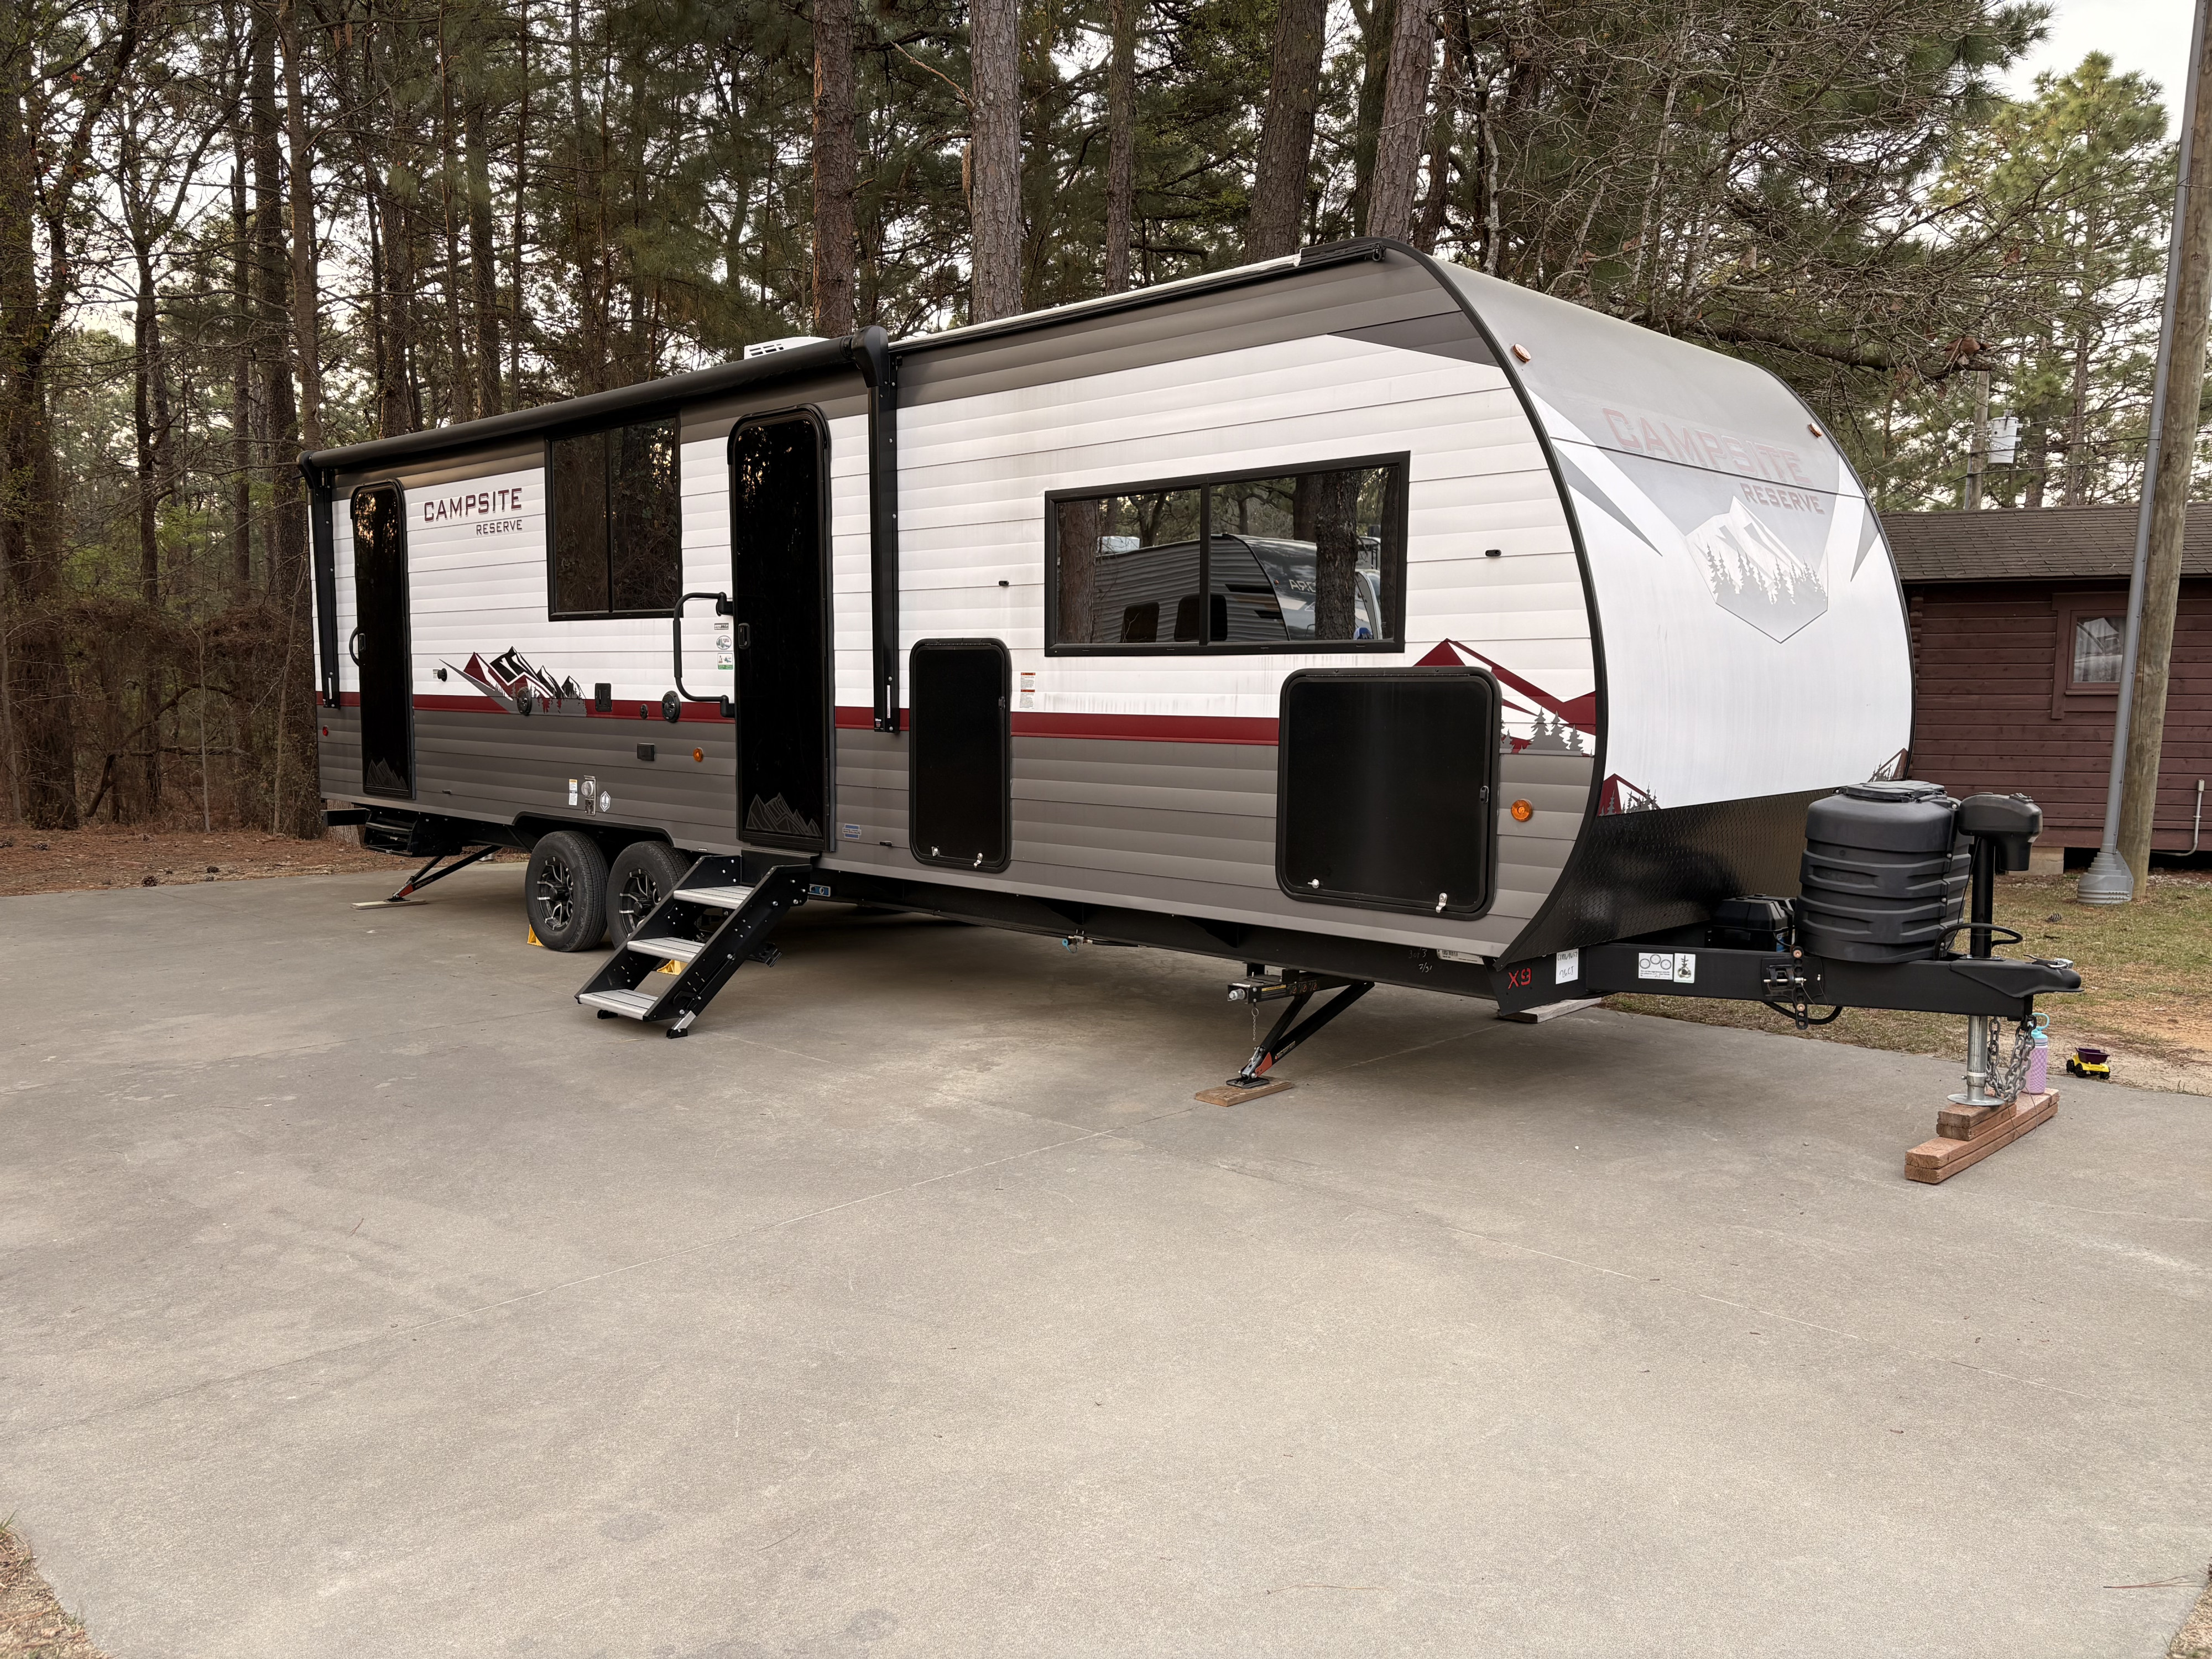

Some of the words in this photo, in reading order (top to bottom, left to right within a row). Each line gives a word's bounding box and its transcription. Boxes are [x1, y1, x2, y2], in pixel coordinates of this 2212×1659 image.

[1602, 408, 1814, 487] CAMPSITE
[424, 487, 522, 522] CAMPSITE
[1740, 483, 1825, 514] RESERVE
[476, 519, 522, 535] RESERVE
[1508, 968, 1531, 989] X9
